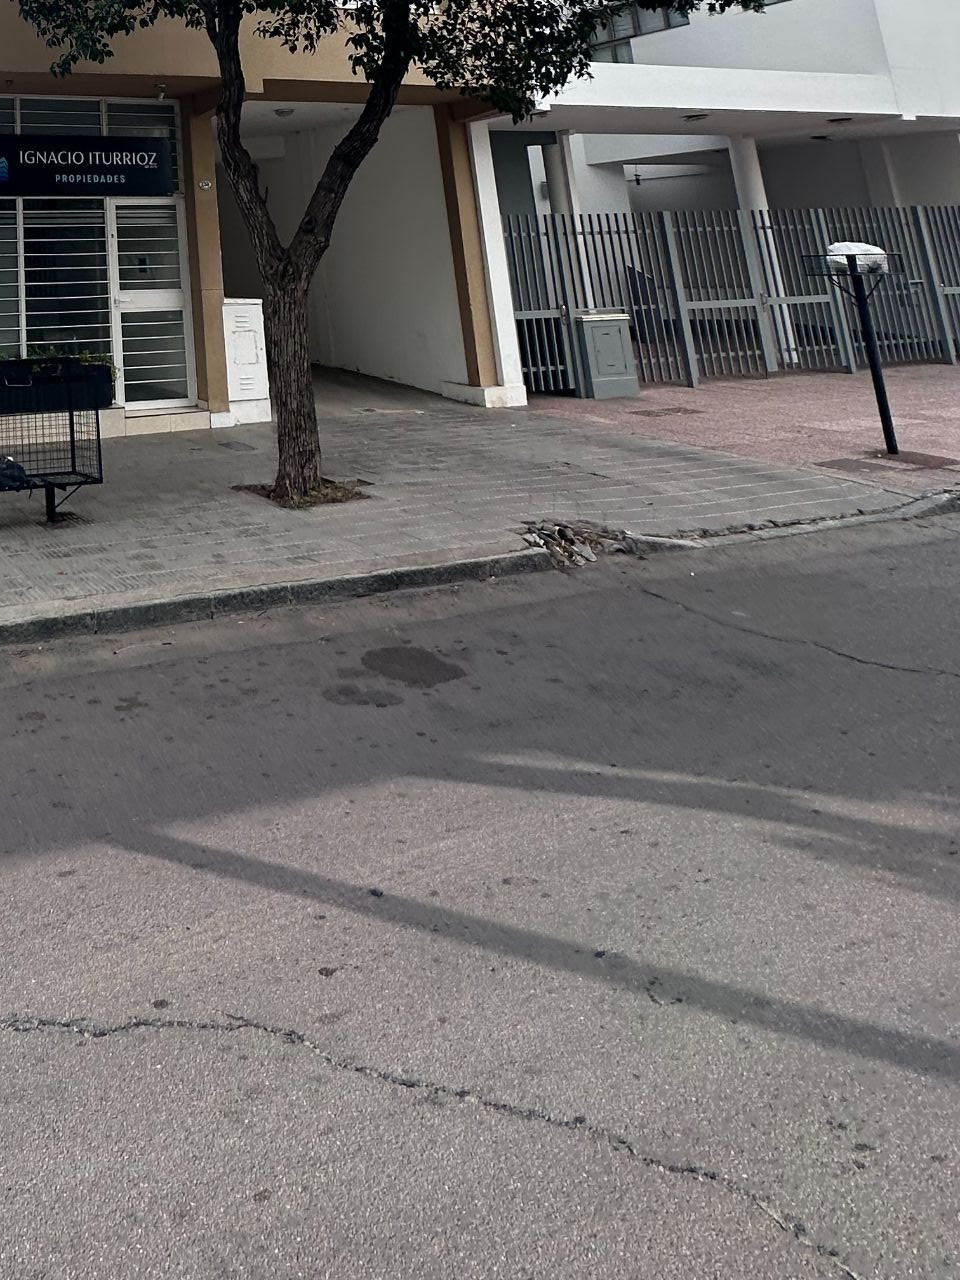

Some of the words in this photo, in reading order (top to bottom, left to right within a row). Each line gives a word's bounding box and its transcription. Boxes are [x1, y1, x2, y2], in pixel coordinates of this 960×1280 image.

[19, 150, 84, 165] IGNACIO
[89, 151, 158, 165] ITURRIOZ
[55, 174, 126, 183] PROPIEDADES
